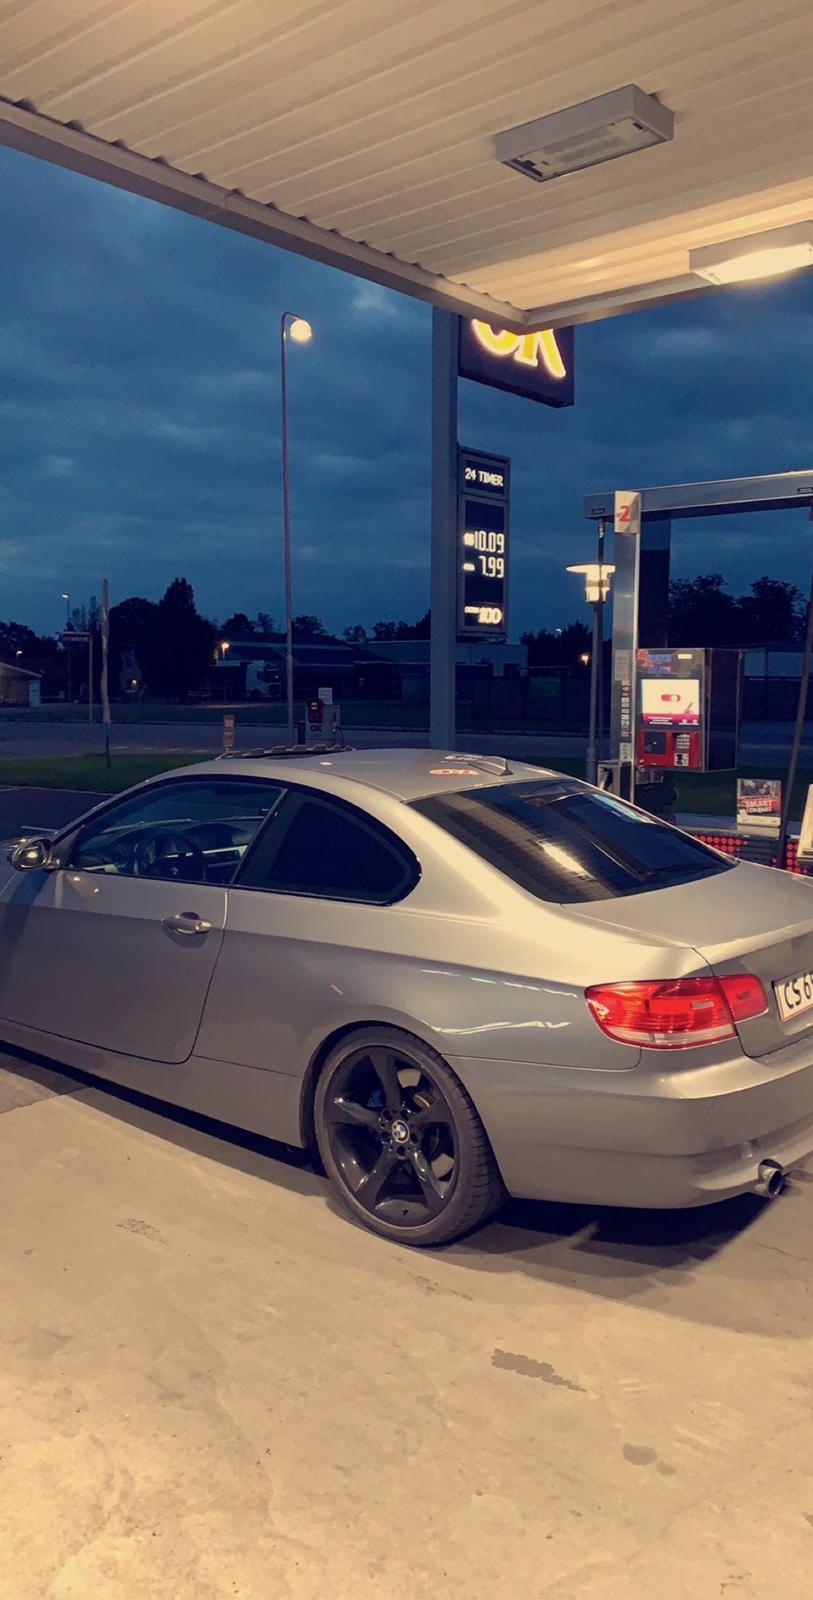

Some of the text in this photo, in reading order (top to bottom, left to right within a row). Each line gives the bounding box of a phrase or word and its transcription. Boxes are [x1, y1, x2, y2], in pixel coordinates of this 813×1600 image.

[465, 467, 504, 487] 24 TIMER
[618, 505, 631, 522] 2
[474, 530, 505, 554] 10.09
[478, 555, 505, 579] 7.99
[784, 977, 802, 1009] CS
